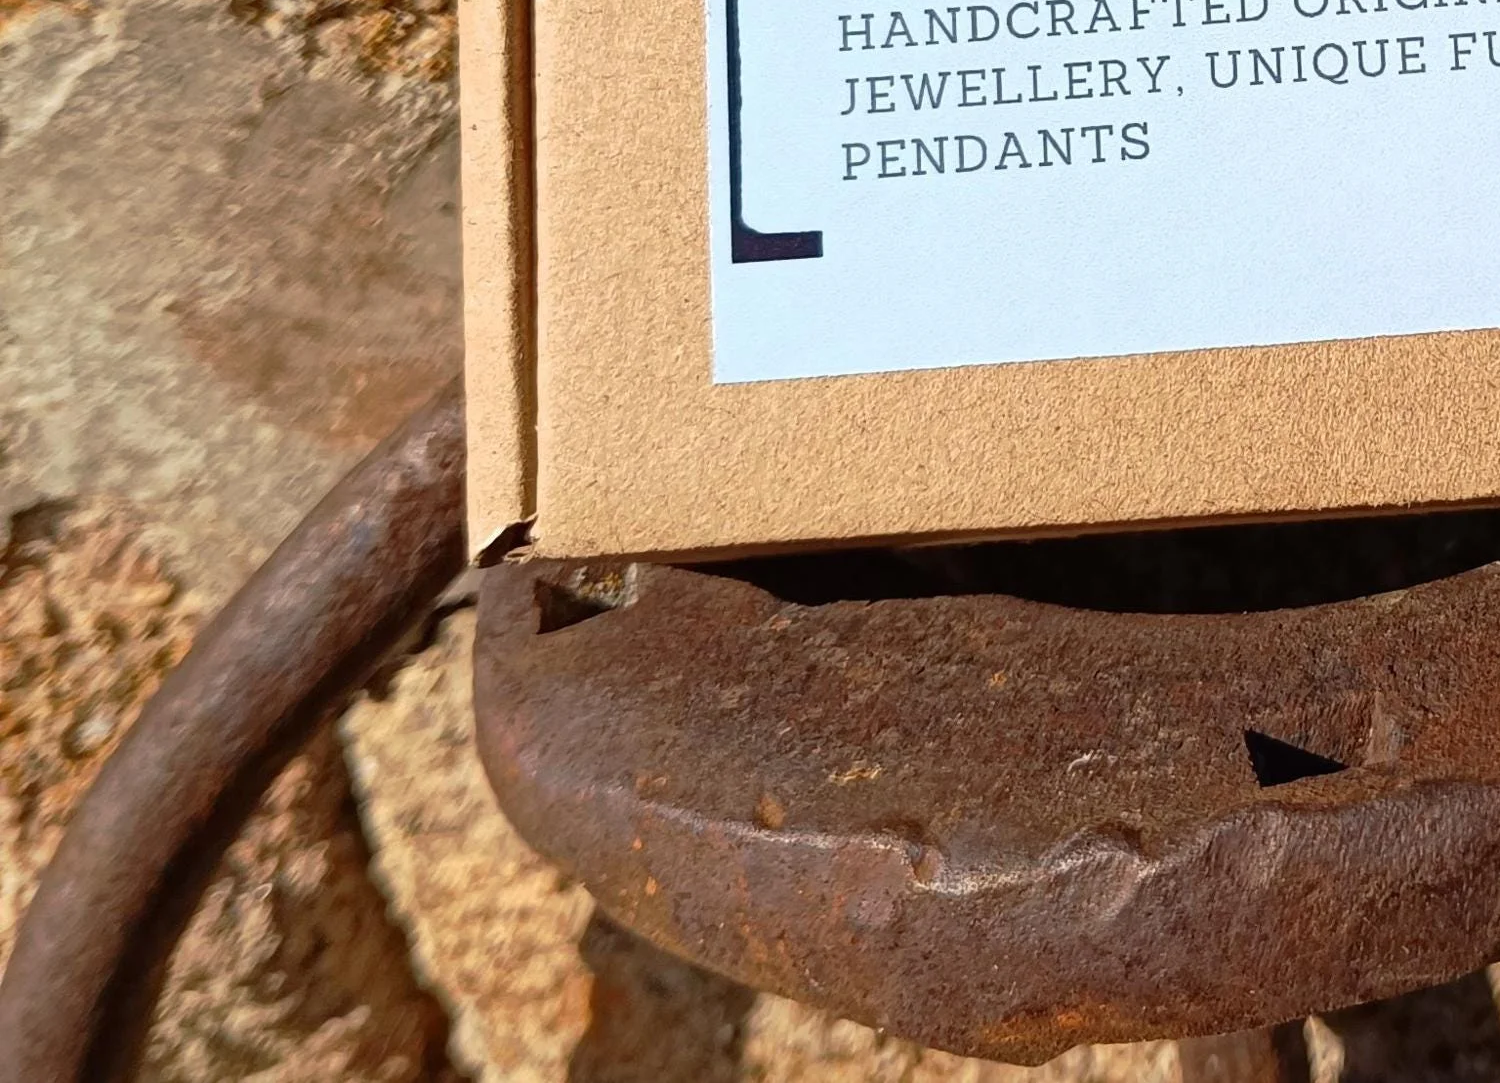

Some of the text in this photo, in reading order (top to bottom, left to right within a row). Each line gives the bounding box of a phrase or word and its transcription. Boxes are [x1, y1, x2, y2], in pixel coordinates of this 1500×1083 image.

[840, 55, 1185, 116] JEWELLERY,
[1205, 36, 1426, 89] UNIQUE
[841, 121, 1150, 181] PENDANTS
